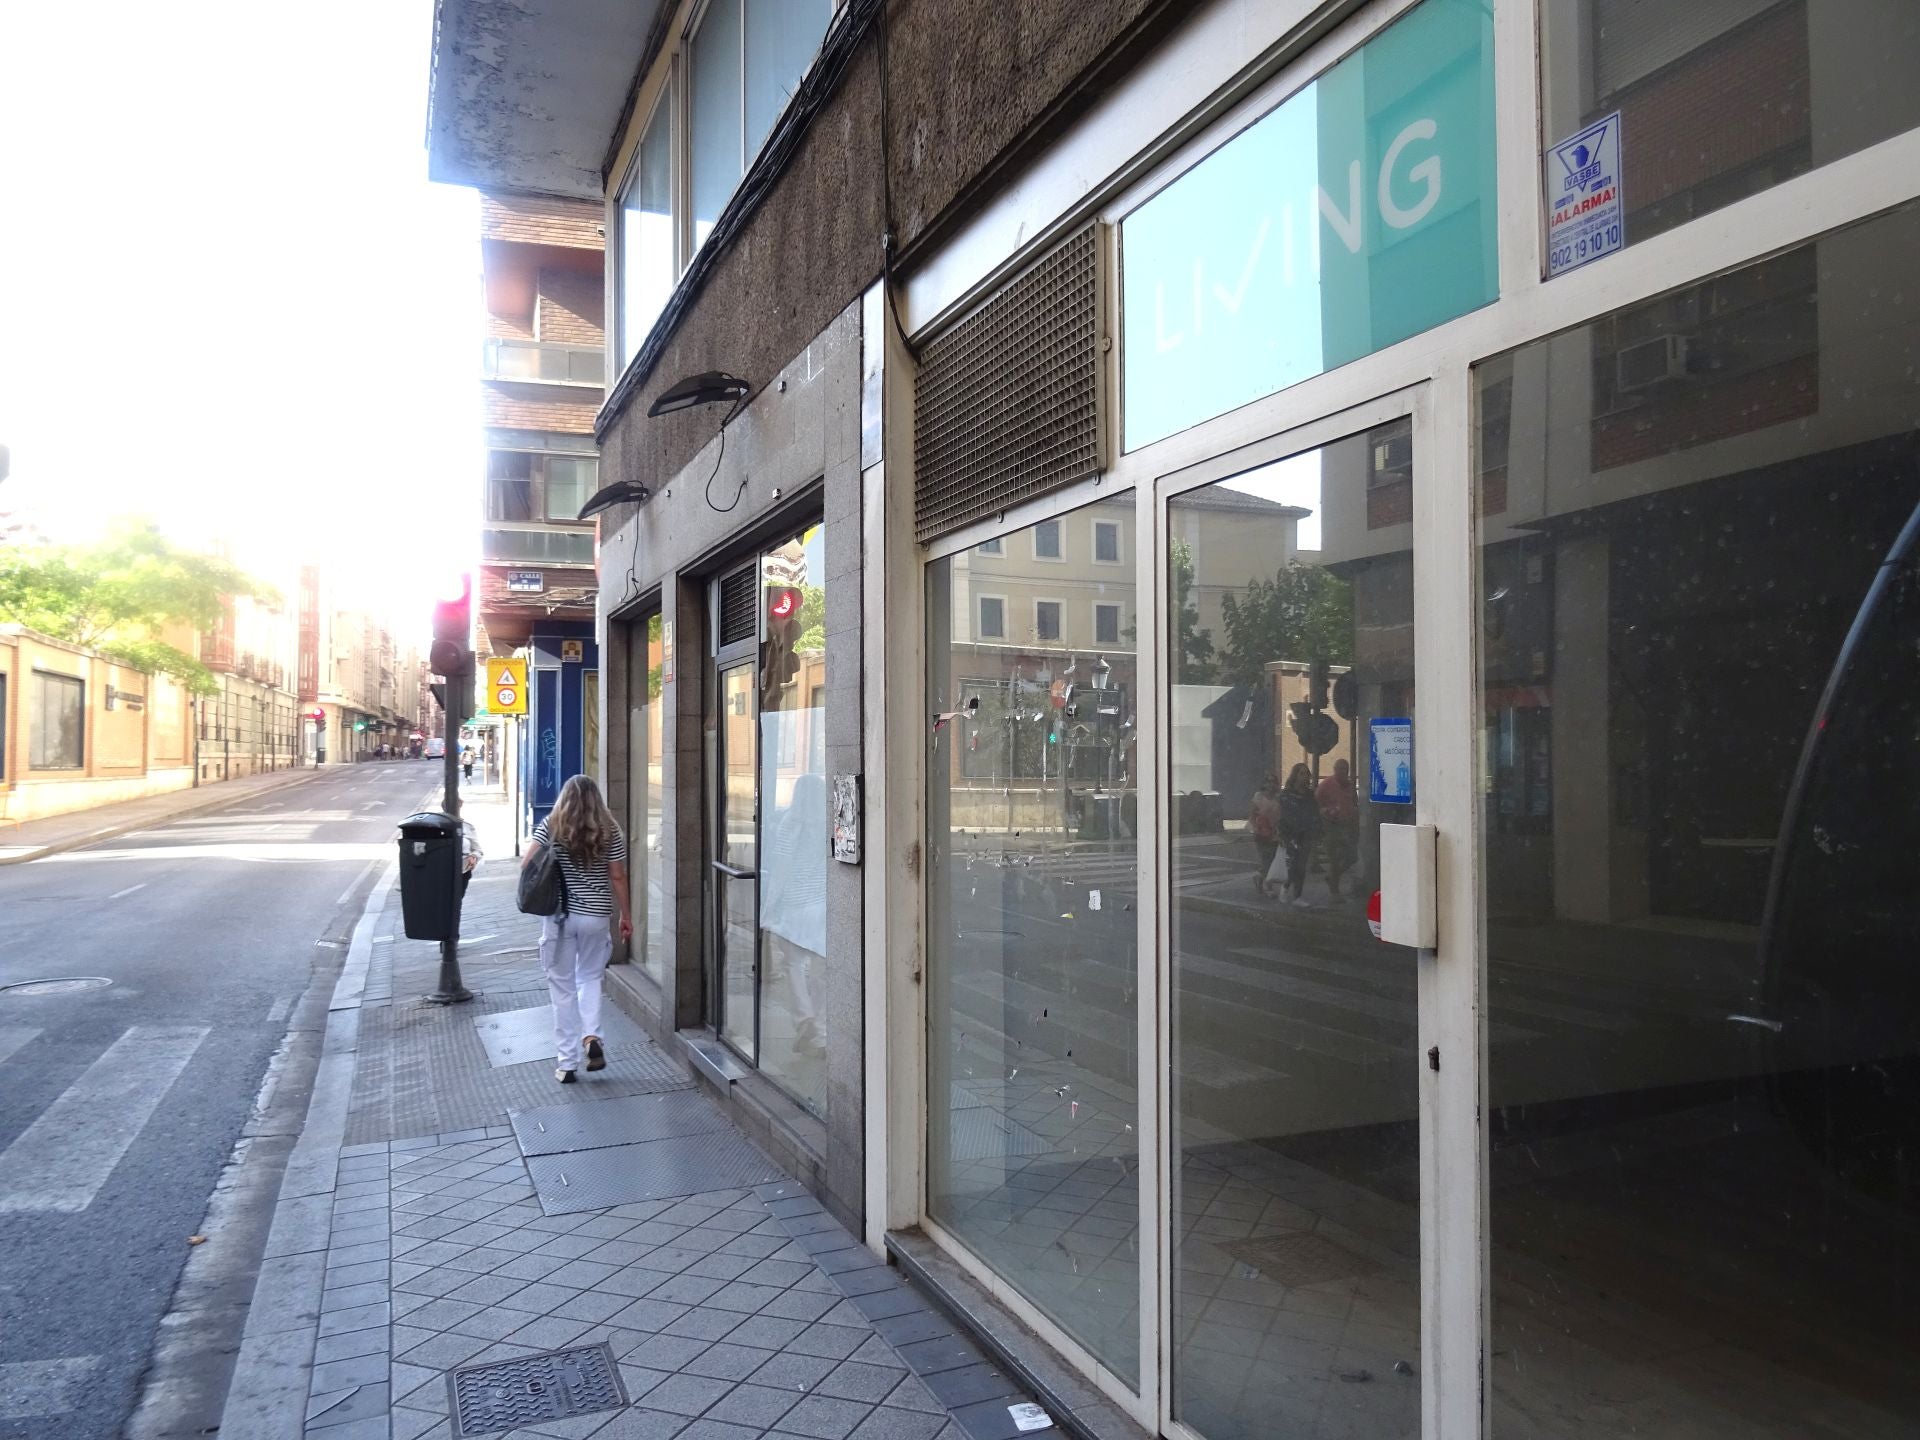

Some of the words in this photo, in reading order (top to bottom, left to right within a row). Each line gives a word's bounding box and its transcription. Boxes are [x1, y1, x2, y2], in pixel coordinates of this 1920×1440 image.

[1551, 187, 1616, 227] ¡ALARMA!
[1155, 118, 1442, 353] LIVING
[1551, 246, 1572, 269] 902
[1575, 239, 1586, 260] 19
[1589, 232, 1602, 253] 10
[1606, 224, 1618, 246] 10
[501, 693, 513, 701] 30
